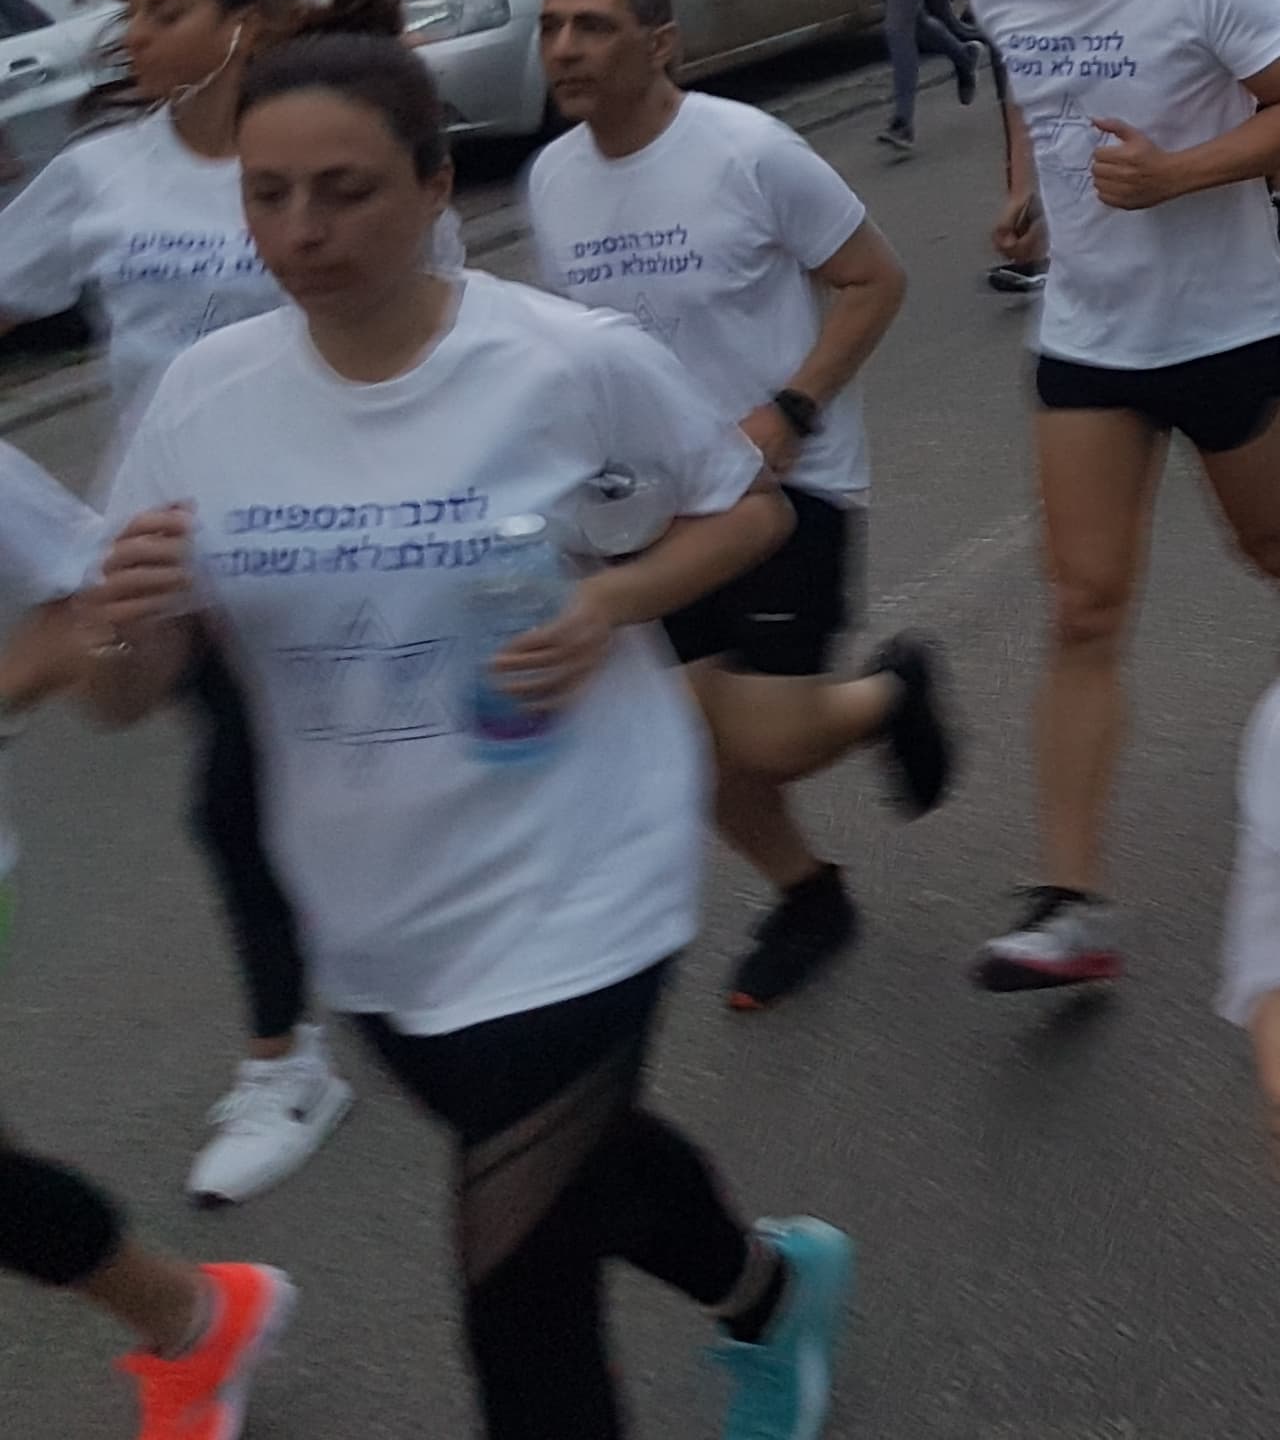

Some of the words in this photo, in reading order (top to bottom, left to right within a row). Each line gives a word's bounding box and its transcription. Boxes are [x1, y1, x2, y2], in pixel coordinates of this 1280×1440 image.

[1081, 29, 1124, 52] לזכר
[1051, 55, 1074, 77] לא
[1080, 55, 1137, 79] לעולם
[573, 233, 640, 259] הנספים
[645, 222, 688, 250] לזכר
[236, 502, 385, 533] הנספים
[395, 486, 490, 527] לזכר
